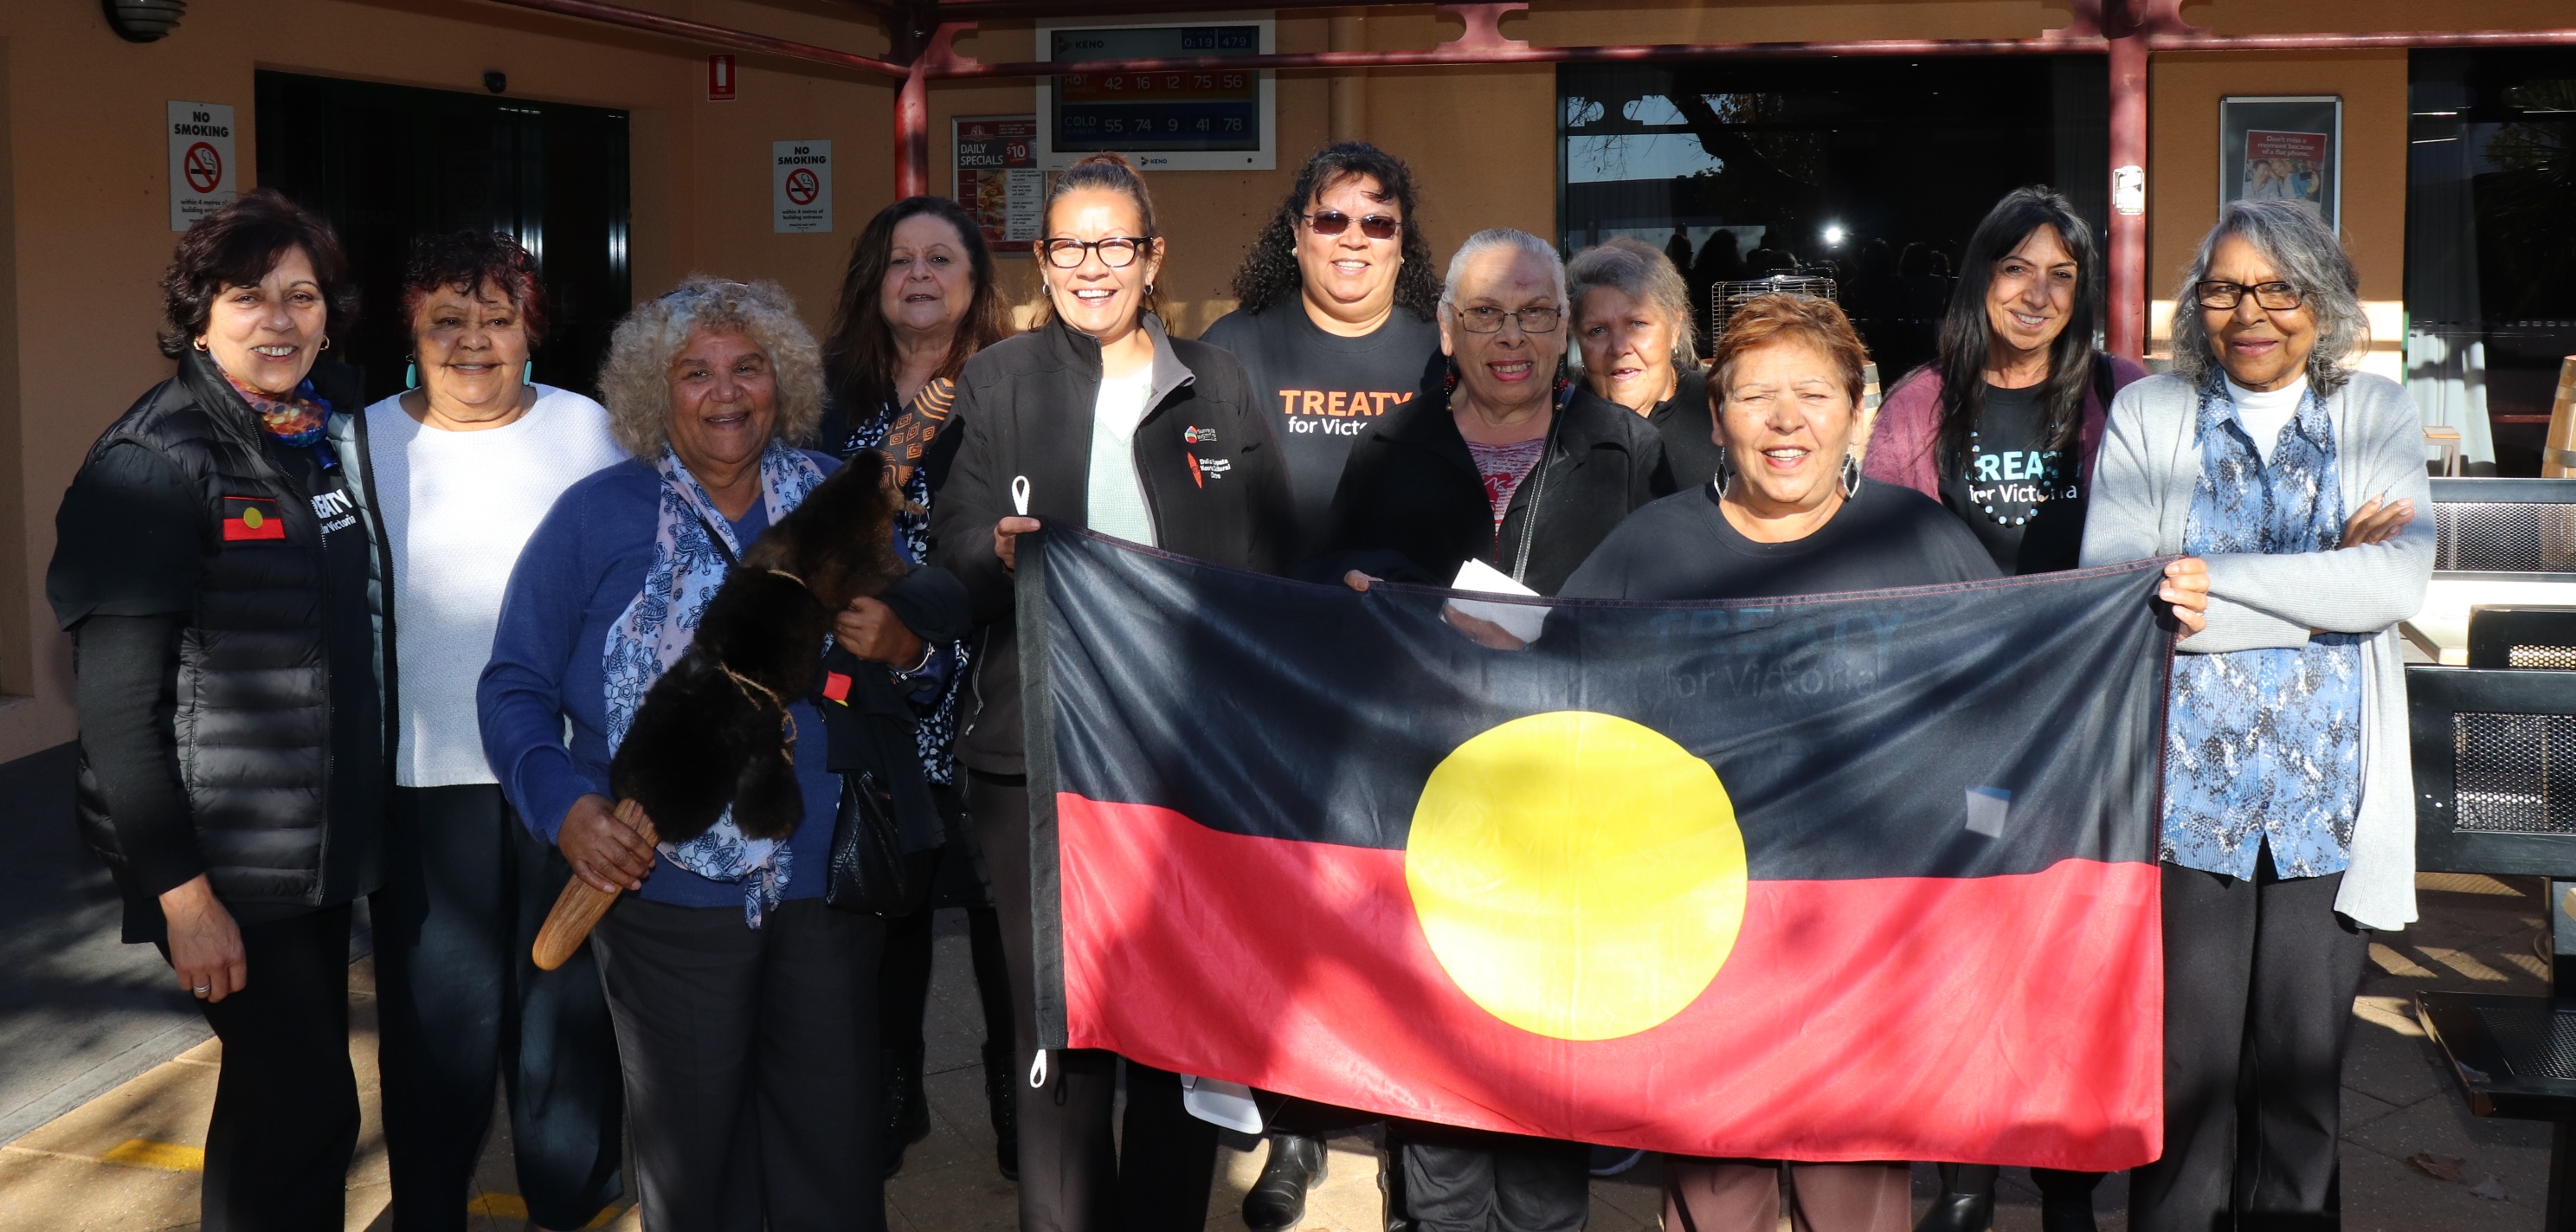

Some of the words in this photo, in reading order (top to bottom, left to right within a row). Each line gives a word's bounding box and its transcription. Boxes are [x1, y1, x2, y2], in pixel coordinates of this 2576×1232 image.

[1075, 40, 1104, 49] KENO
[1184, 37, 1212, 48] 0:19
[1222, 36, 1246, 47] 479
[1065, 74, 1087, 85] HOT
[1104, 77, 1123, 90] 42
[1136, 77, 1150, 90] 16
[1165, 76, 1180, 89] 12
[1194, 75, 1212, 88] 75
[1223, 74, 1243, 88] 56
[193, 111, 210, 122] NO
[1065, 116, 1097, 126] COLD
[1104, 119, 1124, 132] 55
[1135, 119, 1152, 132] 74
[1168, 119, 1178, 132] 9
[1195, 118, 1210, 131] 41
[1223, 118, 1242, 131] 78
[174, 123, 229, 138] SMOKING
[794, 146, 809, 155] NO
[960, 144, 987, 154] DAILY
[1006, 145, 1026, 158] $10
[777, 156, 827, 164] SMOKING
[960, 155, 1003, 165] SPECIALS
[182, 206, 203, 215] building
[1279, 390, 1413, 416] TREATY
[1288, 416, 1317, 434] for
[1321, 418, 1368, 435] Vict
[311, 488, 353, 519] REATY
[326, 513, 357, 532] Victoria
[1725, 661, 1875, 700] Victor
